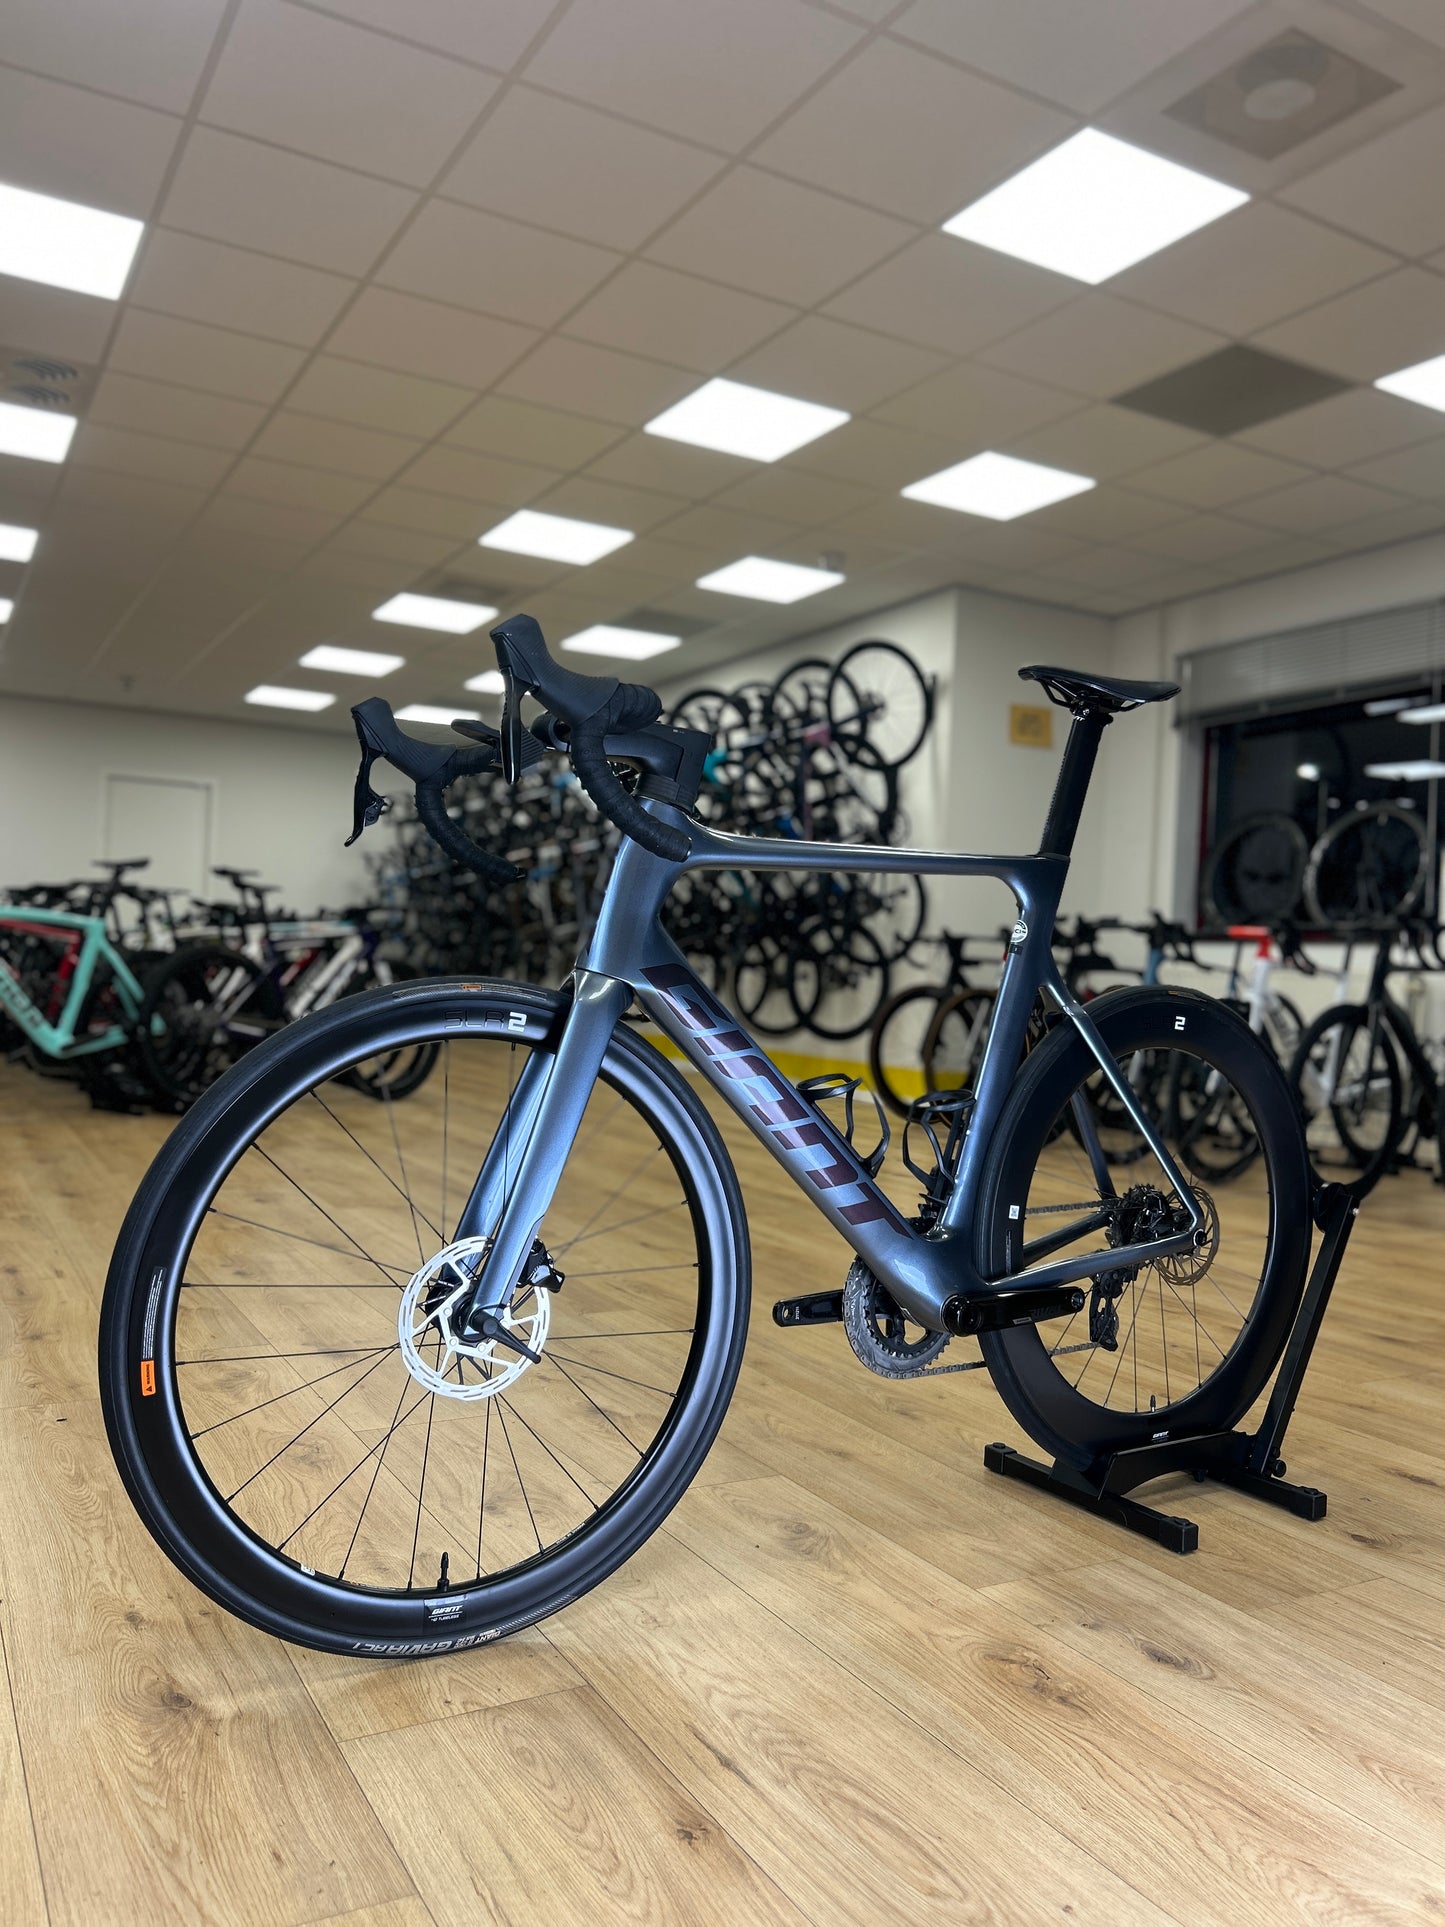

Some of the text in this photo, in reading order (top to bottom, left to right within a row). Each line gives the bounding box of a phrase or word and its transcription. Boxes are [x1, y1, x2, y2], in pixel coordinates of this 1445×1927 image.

[444, 1009, 527, 1032] SLR 2
[1174, 1015, 1186, 1031] 2
[639, 963, 914, 1240] GIANT
[431, 1605, 463, 1614] GIANT
[385, 1640, 453, 1655] GAVIA
